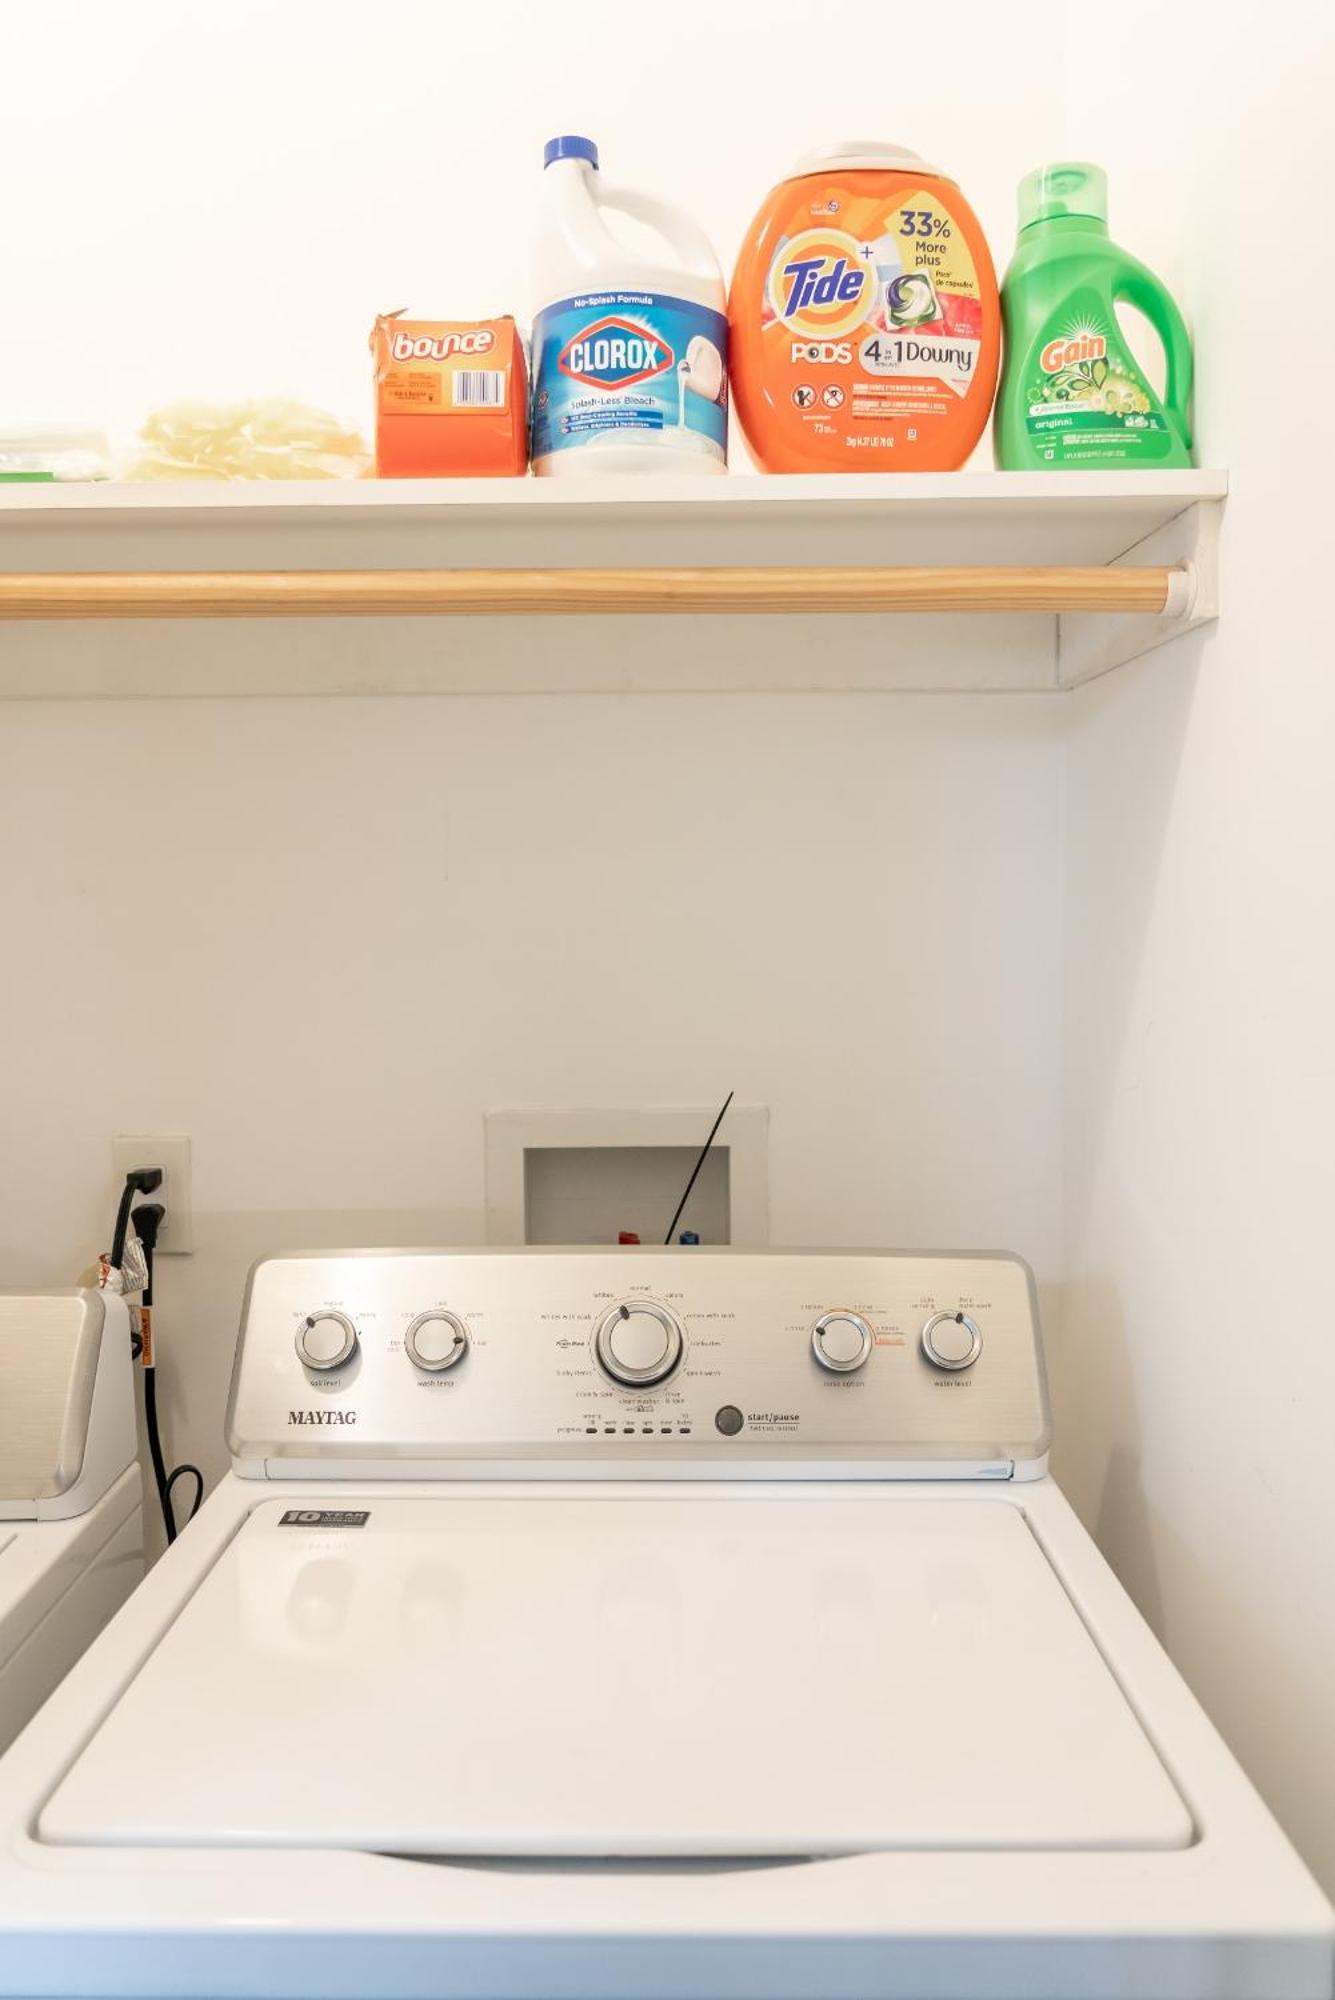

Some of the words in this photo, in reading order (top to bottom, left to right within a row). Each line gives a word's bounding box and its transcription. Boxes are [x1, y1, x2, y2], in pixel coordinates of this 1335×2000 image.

[900, 210, 951, 239] 33%
[915, 241, 946, 254] More
[915, 254, 941, 267] plus
[784, 259, 864, 317] Tide
[618, 295, 653, 305] Formula
[393, 330, 493, 362] bounce
[791, 342, 853, 364] PODS
[1042, 335, 1105, 372] Gain
[570, 338, 659, 373] CLOROX
[864, 341, 881, 362] 4
[906, 342, 972, 373] Downy
[624, 396, 655, 406] Bleach
[287, 1411, 356, 1425] MAYTAG
[747, 1412, 800, 1423] start/pause
[286, 1511, 321, 1523] 10
